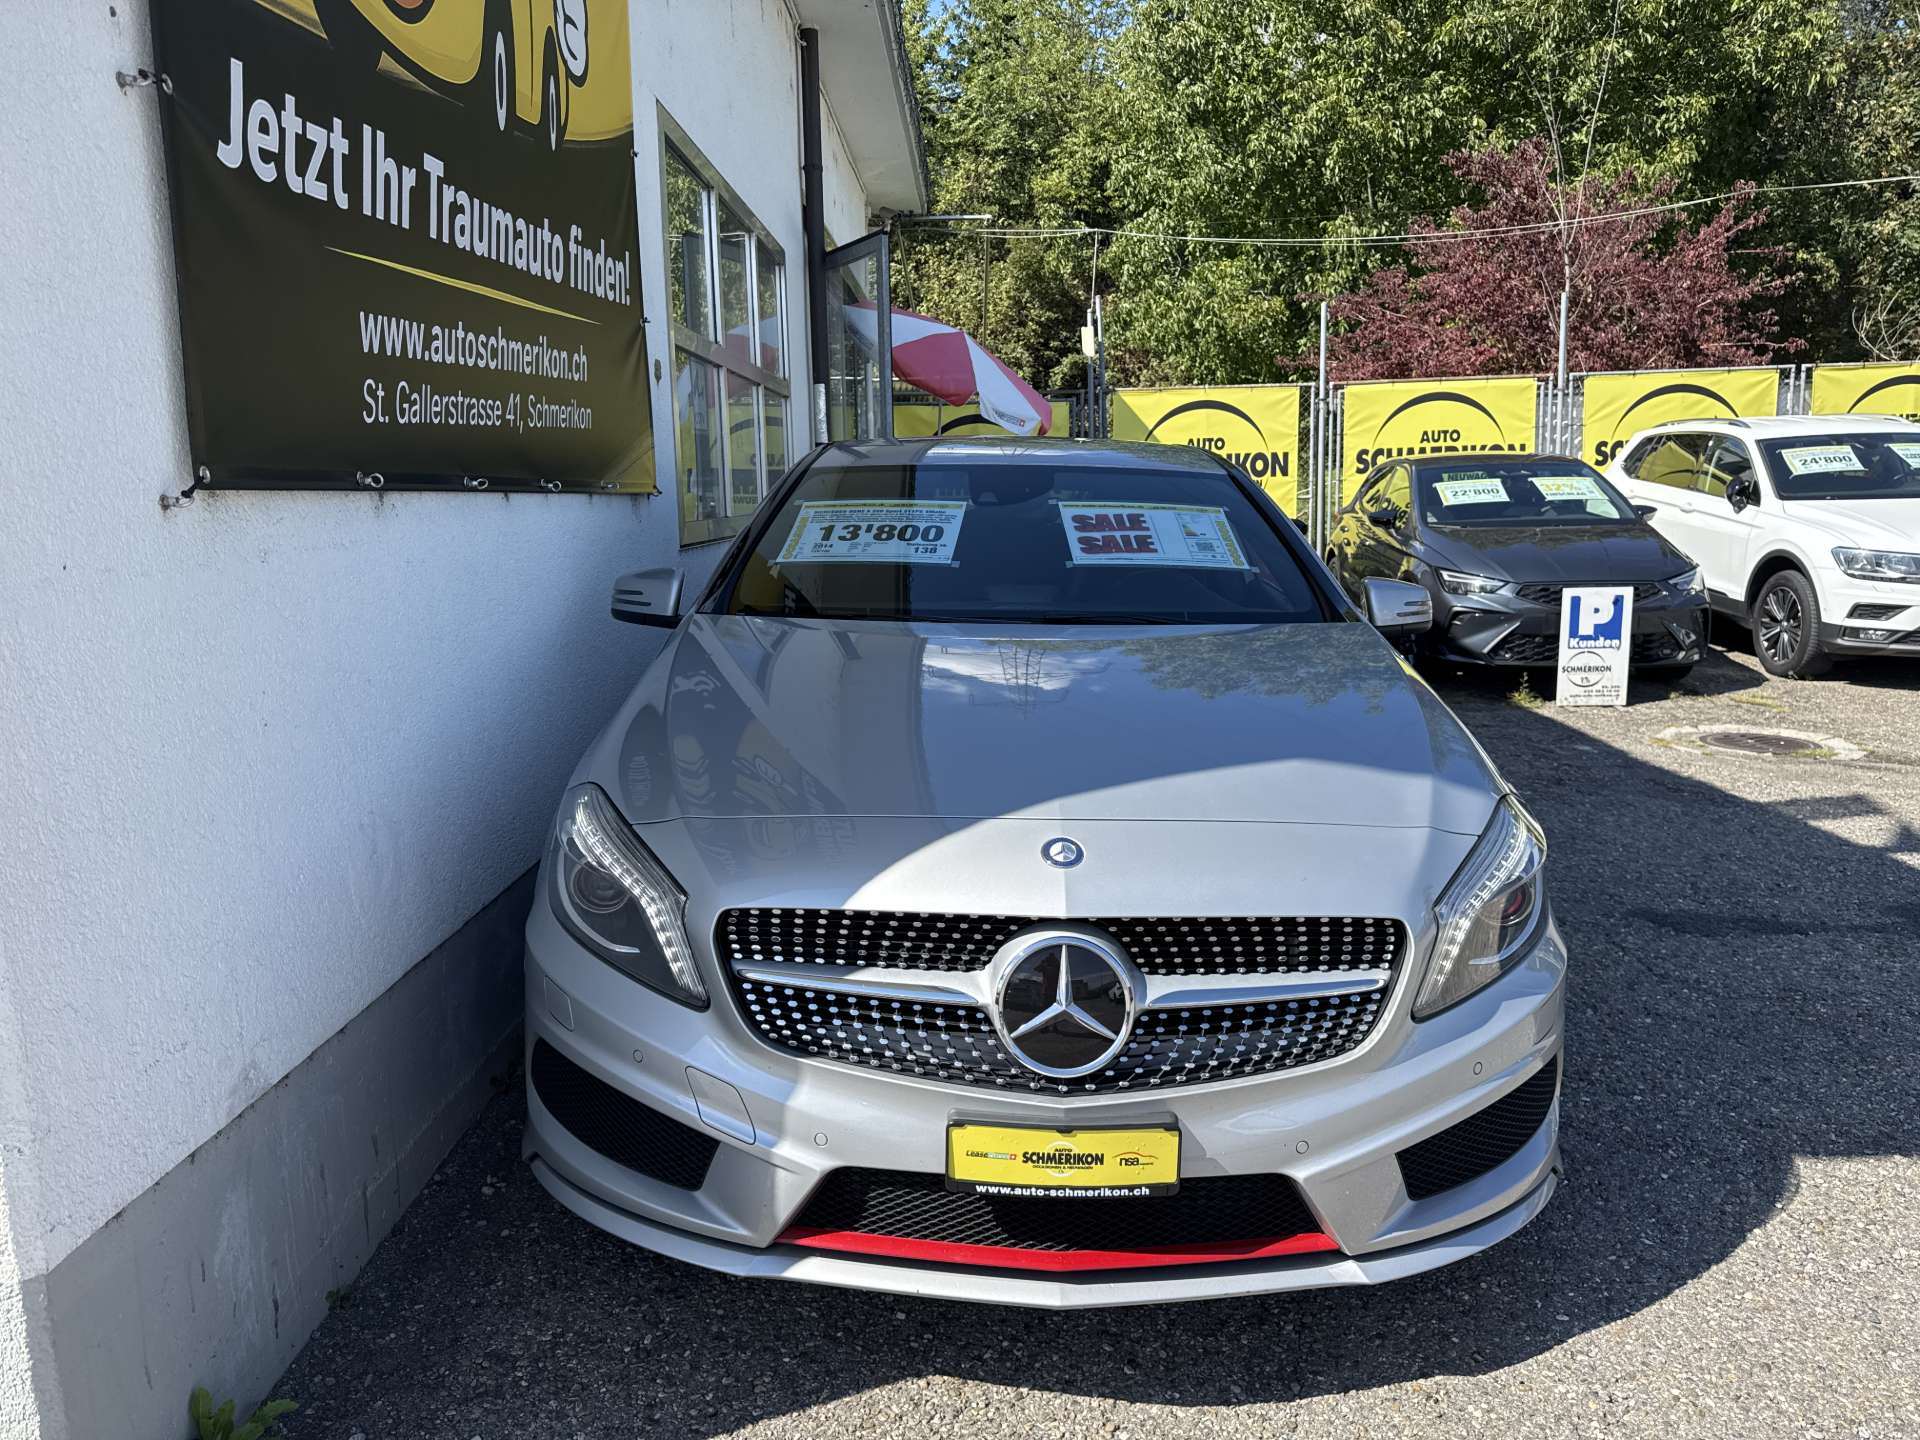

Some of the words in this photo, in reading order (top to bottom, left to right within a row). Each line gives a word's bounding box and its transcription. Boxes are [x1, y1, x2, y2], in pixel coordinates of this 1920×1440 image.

[216, 57, 349, 210] Jetzt
[362, 123, 416, 229] Ihr
[423, 152, 564, 284] Traumauto
[569, 223, 631, 306] finden!
[359, 311, 588, 383] www.autoschmerikon.ch
[363, 378, 389, 426] St.
[396, 380, 502, 429] Gallerstrasse
[505, 391, 524, 435] 41,
[528, 395, 593, 430] Schmerikon
[1187, 437, 1226, 450] AUTO
[1420, 429, 1461, 443] AUTO
[1800, 455, 1853, 466] 24'800
[1071, 513, 1151, 532] SALE
[819, 523, 945, 543] 13'800
[1077, 534, 1158, 555] SALE
[1569, 637, 1620, 649] Kunden
[1562, 665, 1612, 673] SCHMERIKON
[1022, 1151, 1104, 1166] SCHMERIKON
[976, 1184, 1150, 1197] www.auto-schmerikon.ch
